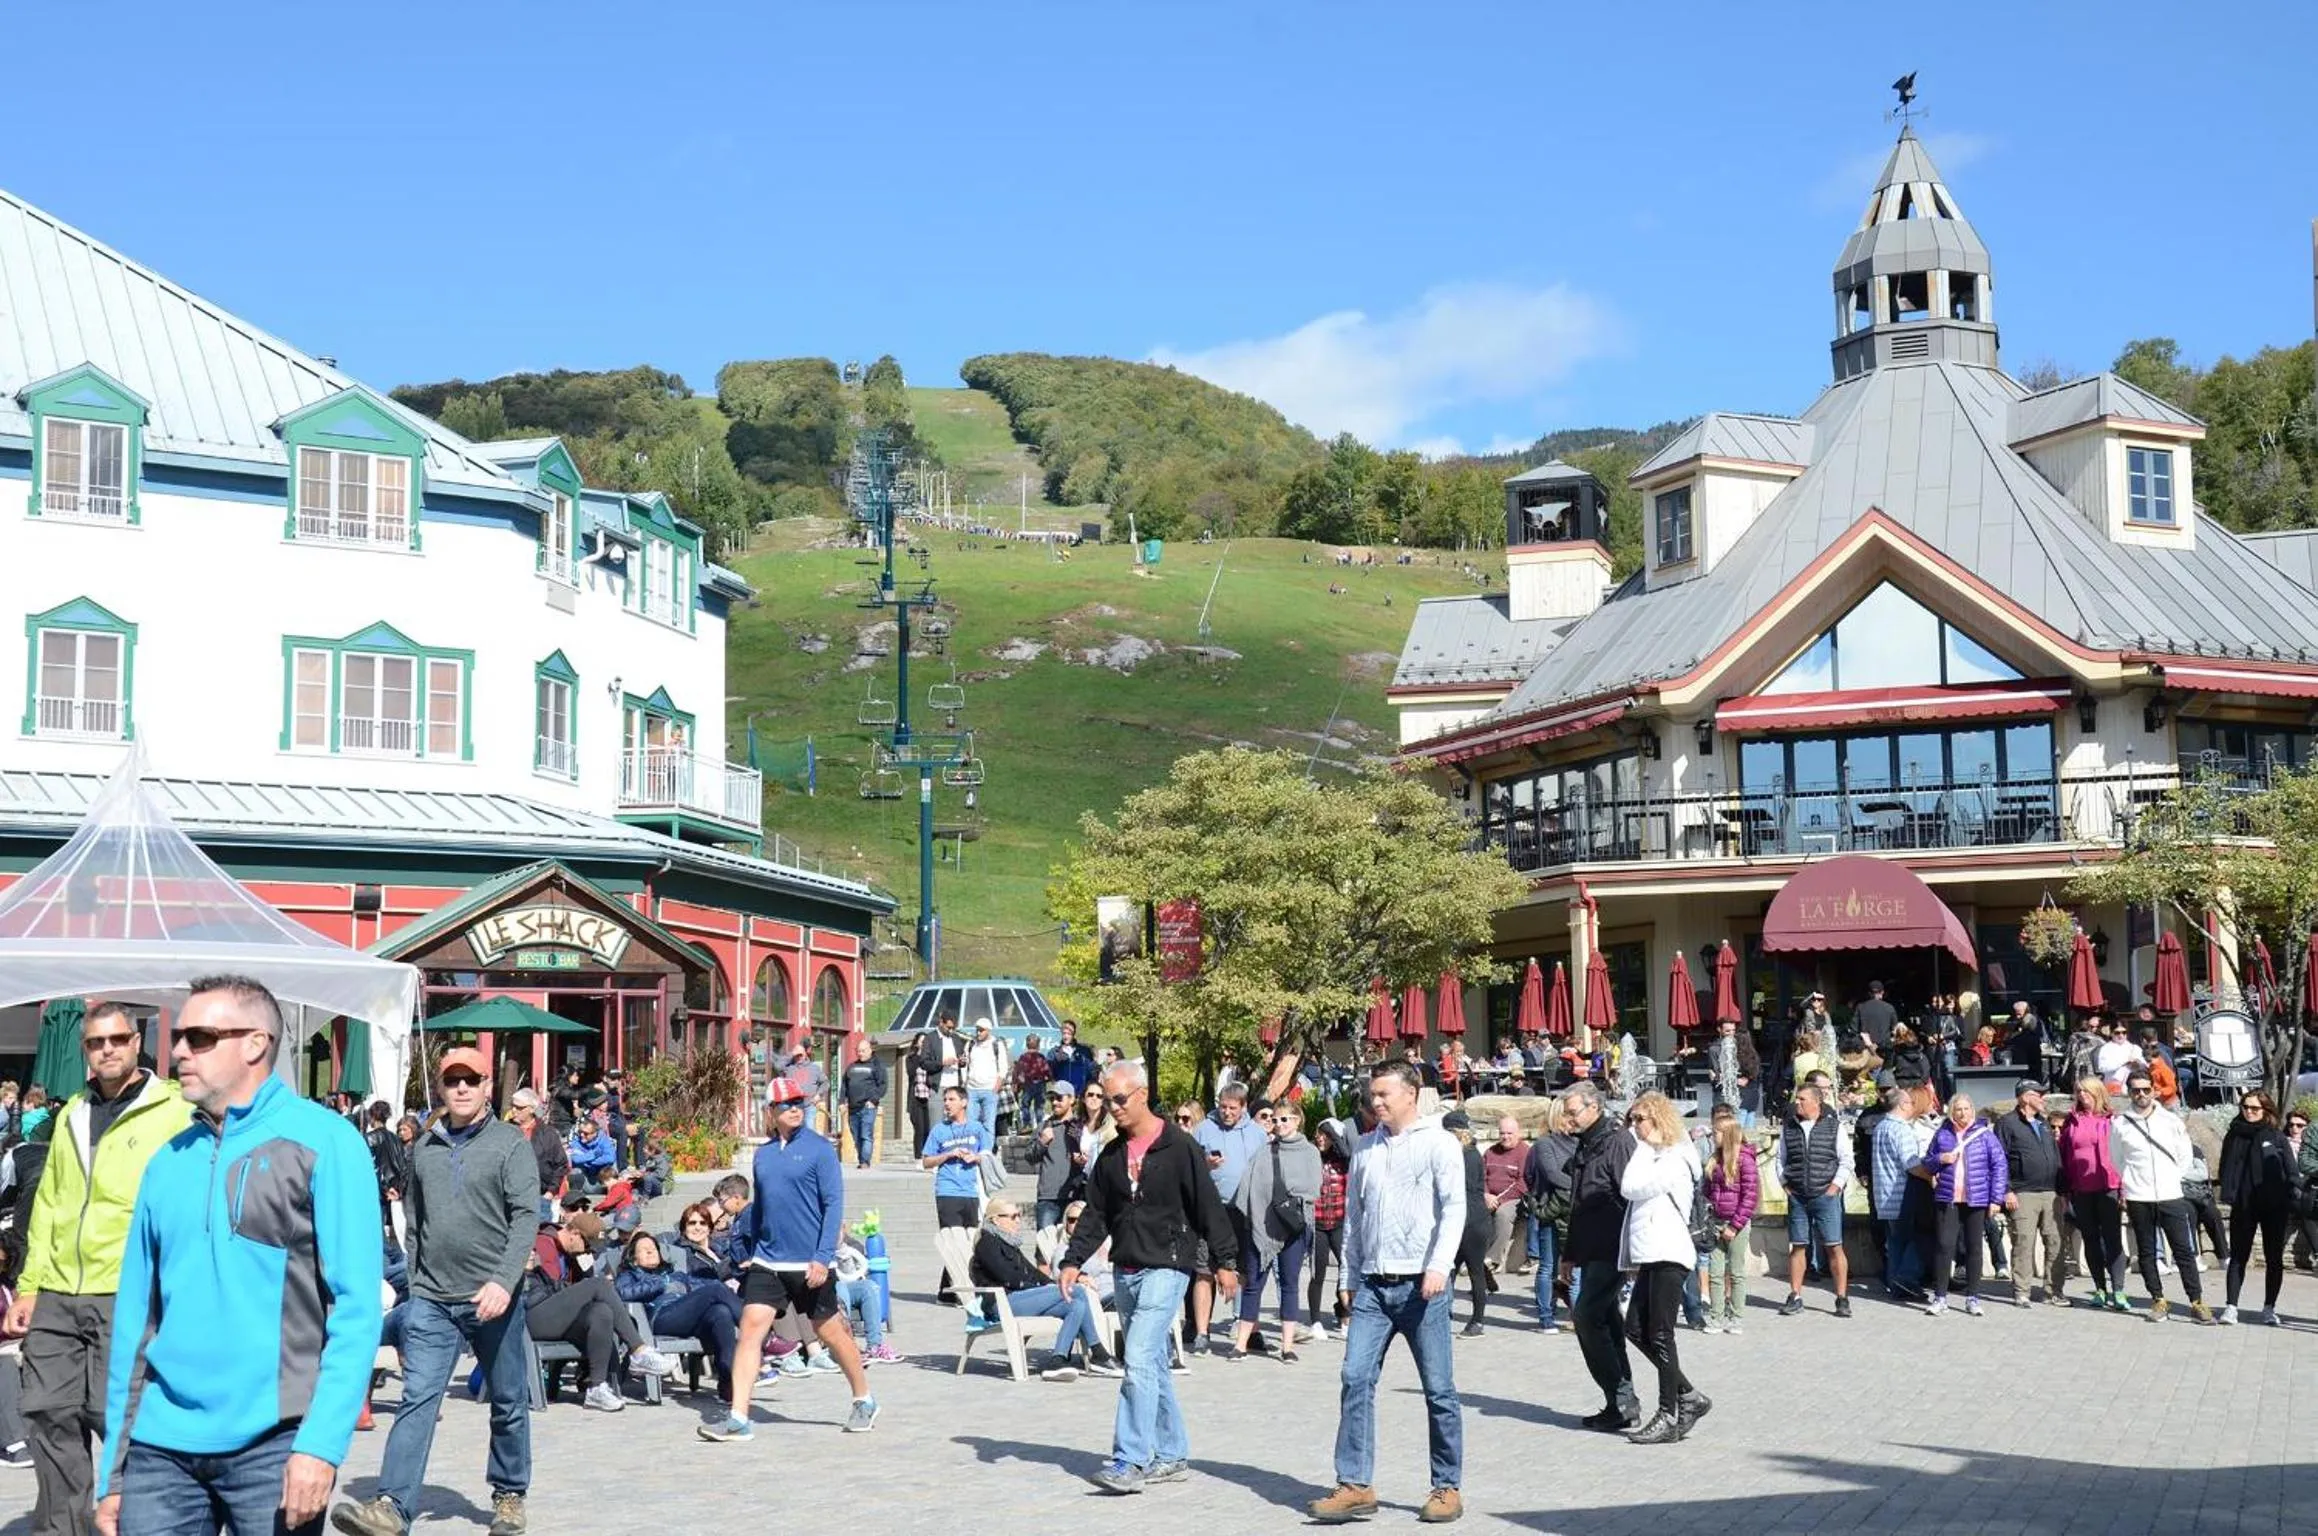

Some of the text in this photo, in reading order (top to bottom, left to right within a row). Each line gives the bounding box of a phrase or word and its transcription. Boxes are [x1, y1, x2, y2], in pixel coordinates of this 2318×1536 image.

[1799, 903, 1825, 919] LA
[1834, 895, 1907, 917] FORGE
[483, 910, 617, 952] LE SHACK
[559, 952, 580, 967] BAR
